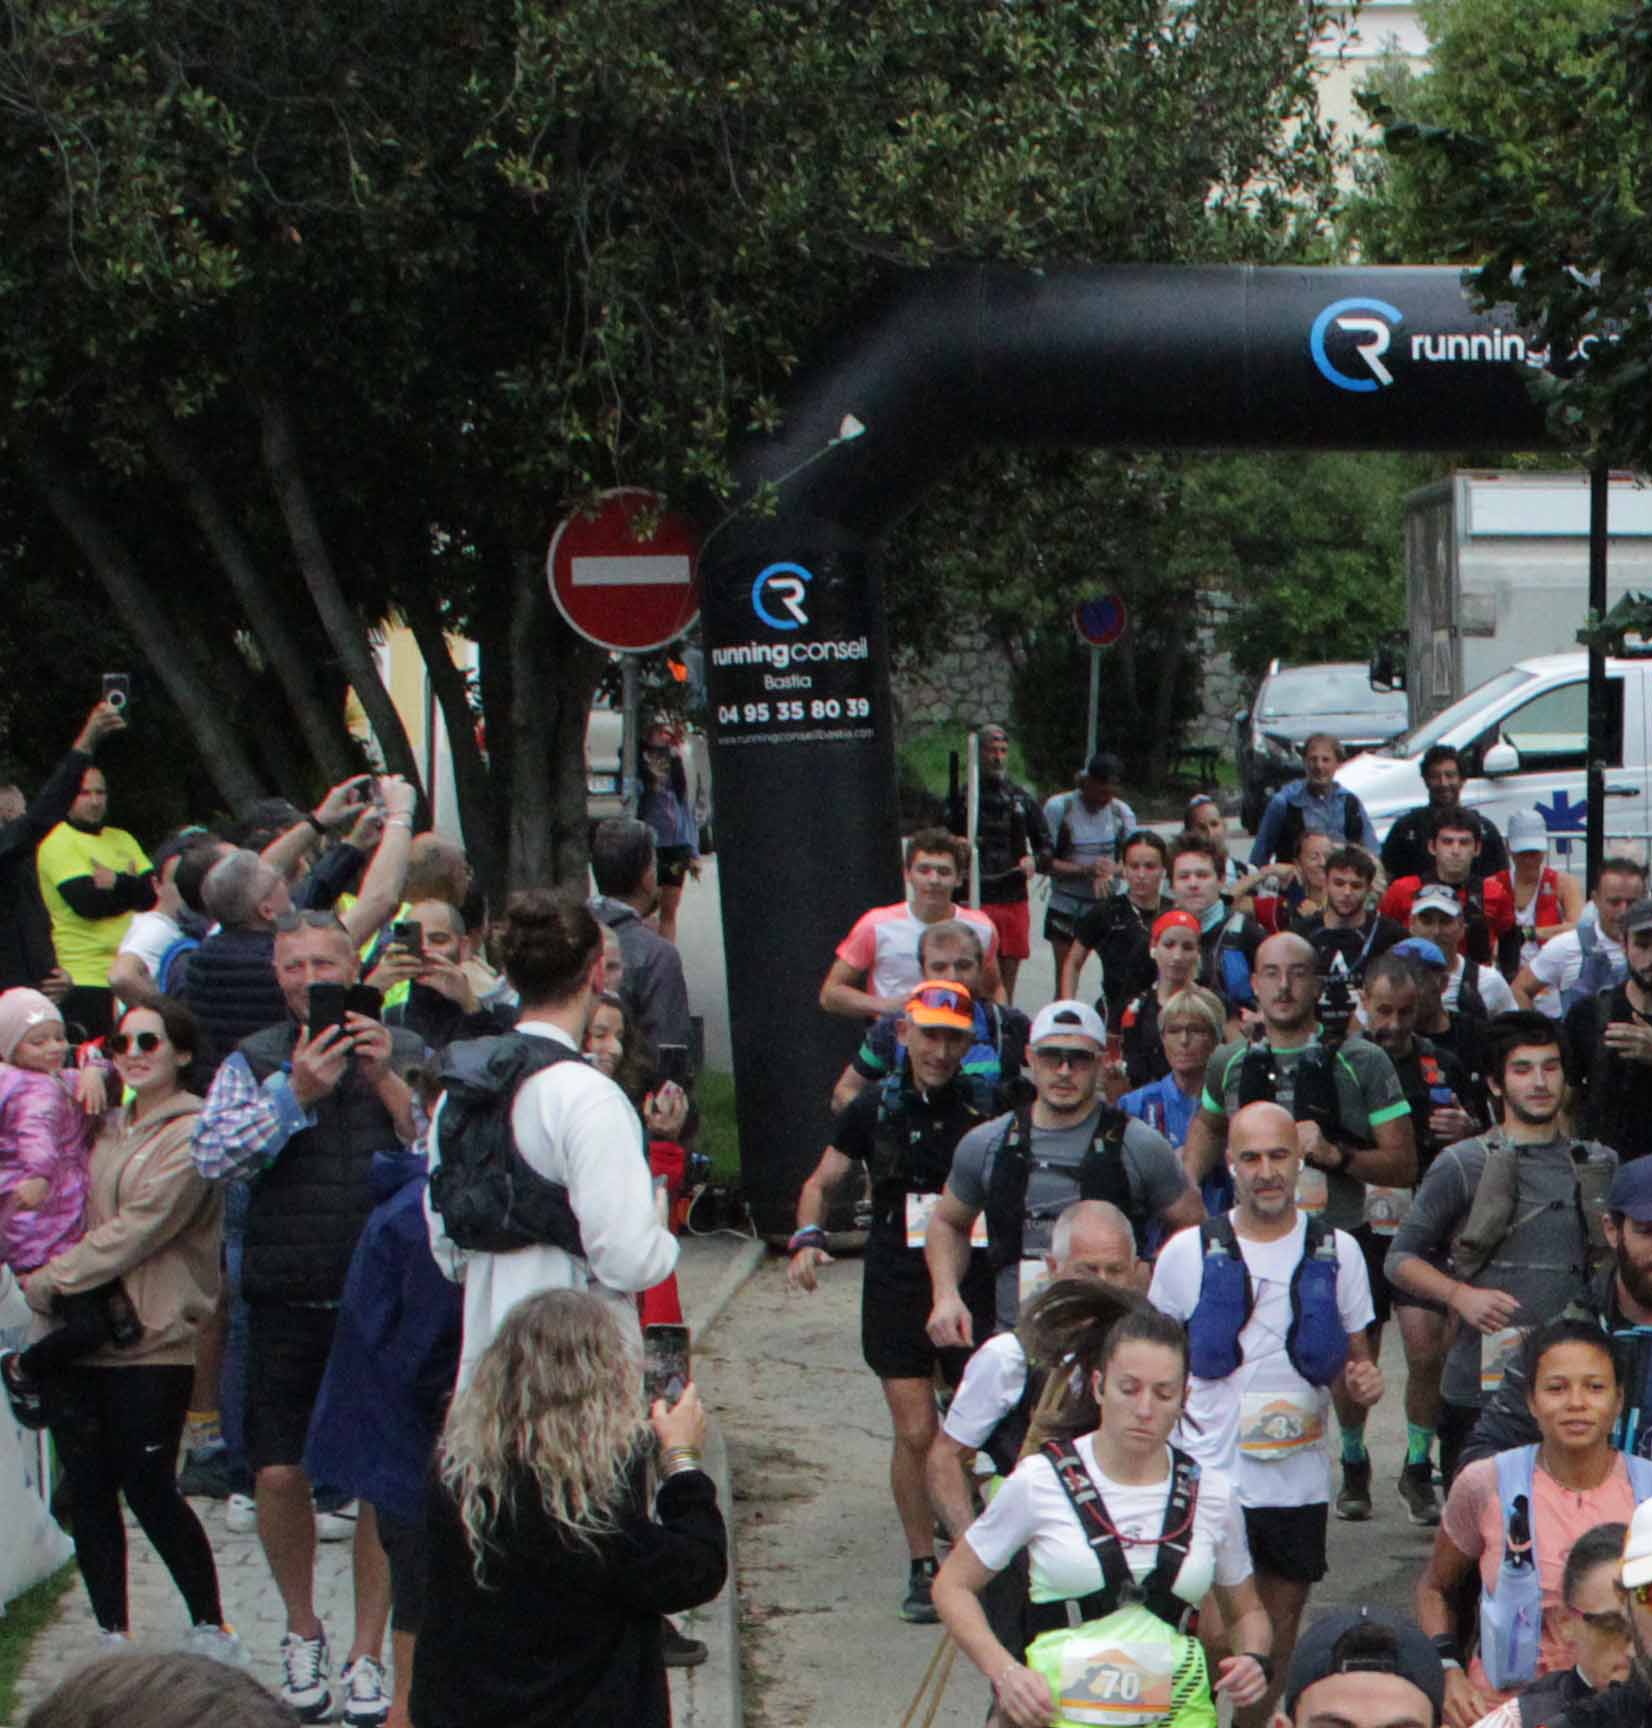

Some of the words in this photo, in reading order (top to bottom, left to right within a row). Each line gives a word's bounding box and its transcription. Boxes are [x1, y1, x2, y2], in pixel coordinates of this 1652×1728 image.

[763, 674, 813, 691] Bastia
[718, 705, 739, 724] 04
[744, 703, 770, 722] 95
[776, 702, 805, 720] 35
[811, 700, 841, 719] 80
[847, 698, 870, 717] 39
[1100, 1669, 1140, 1701] 70
